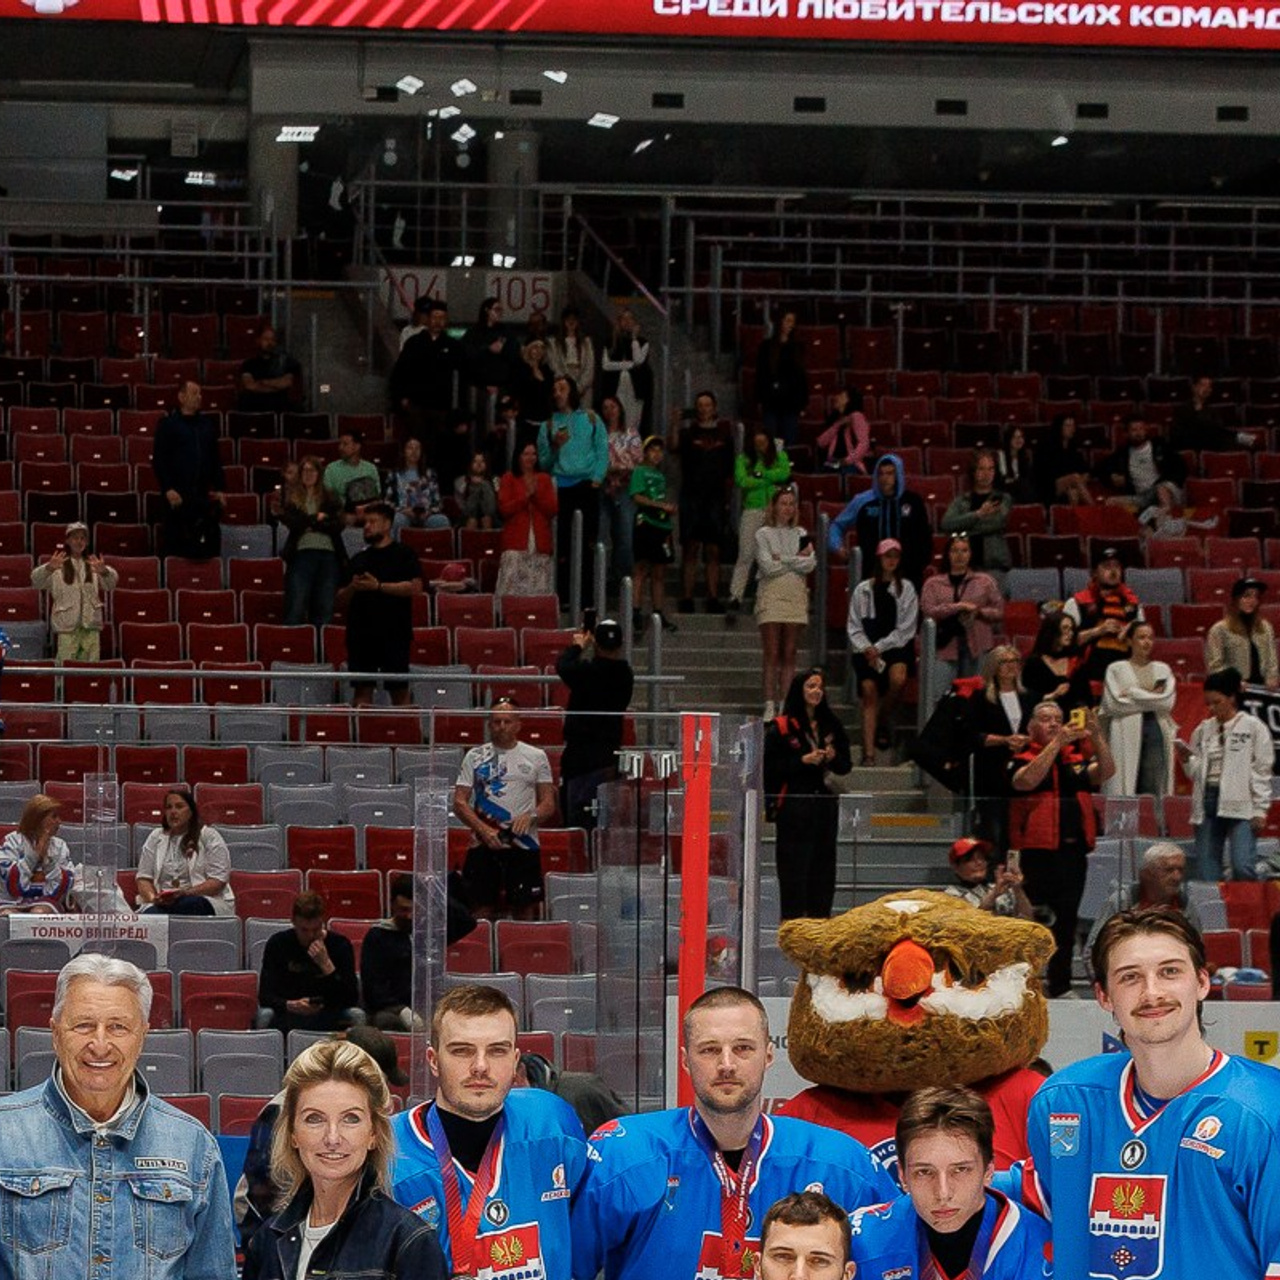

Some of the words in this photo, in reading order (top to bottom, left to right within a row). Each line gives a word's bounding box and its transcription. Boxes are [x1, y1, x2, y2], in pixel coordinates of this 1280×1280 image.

[652, 0, 788, 18] СРЕДИ
[796, 0, 1121, 26] ЛЮБИТЕЛЬСКИХ
[31, 926, 83, 939] ТОЛЬКО
